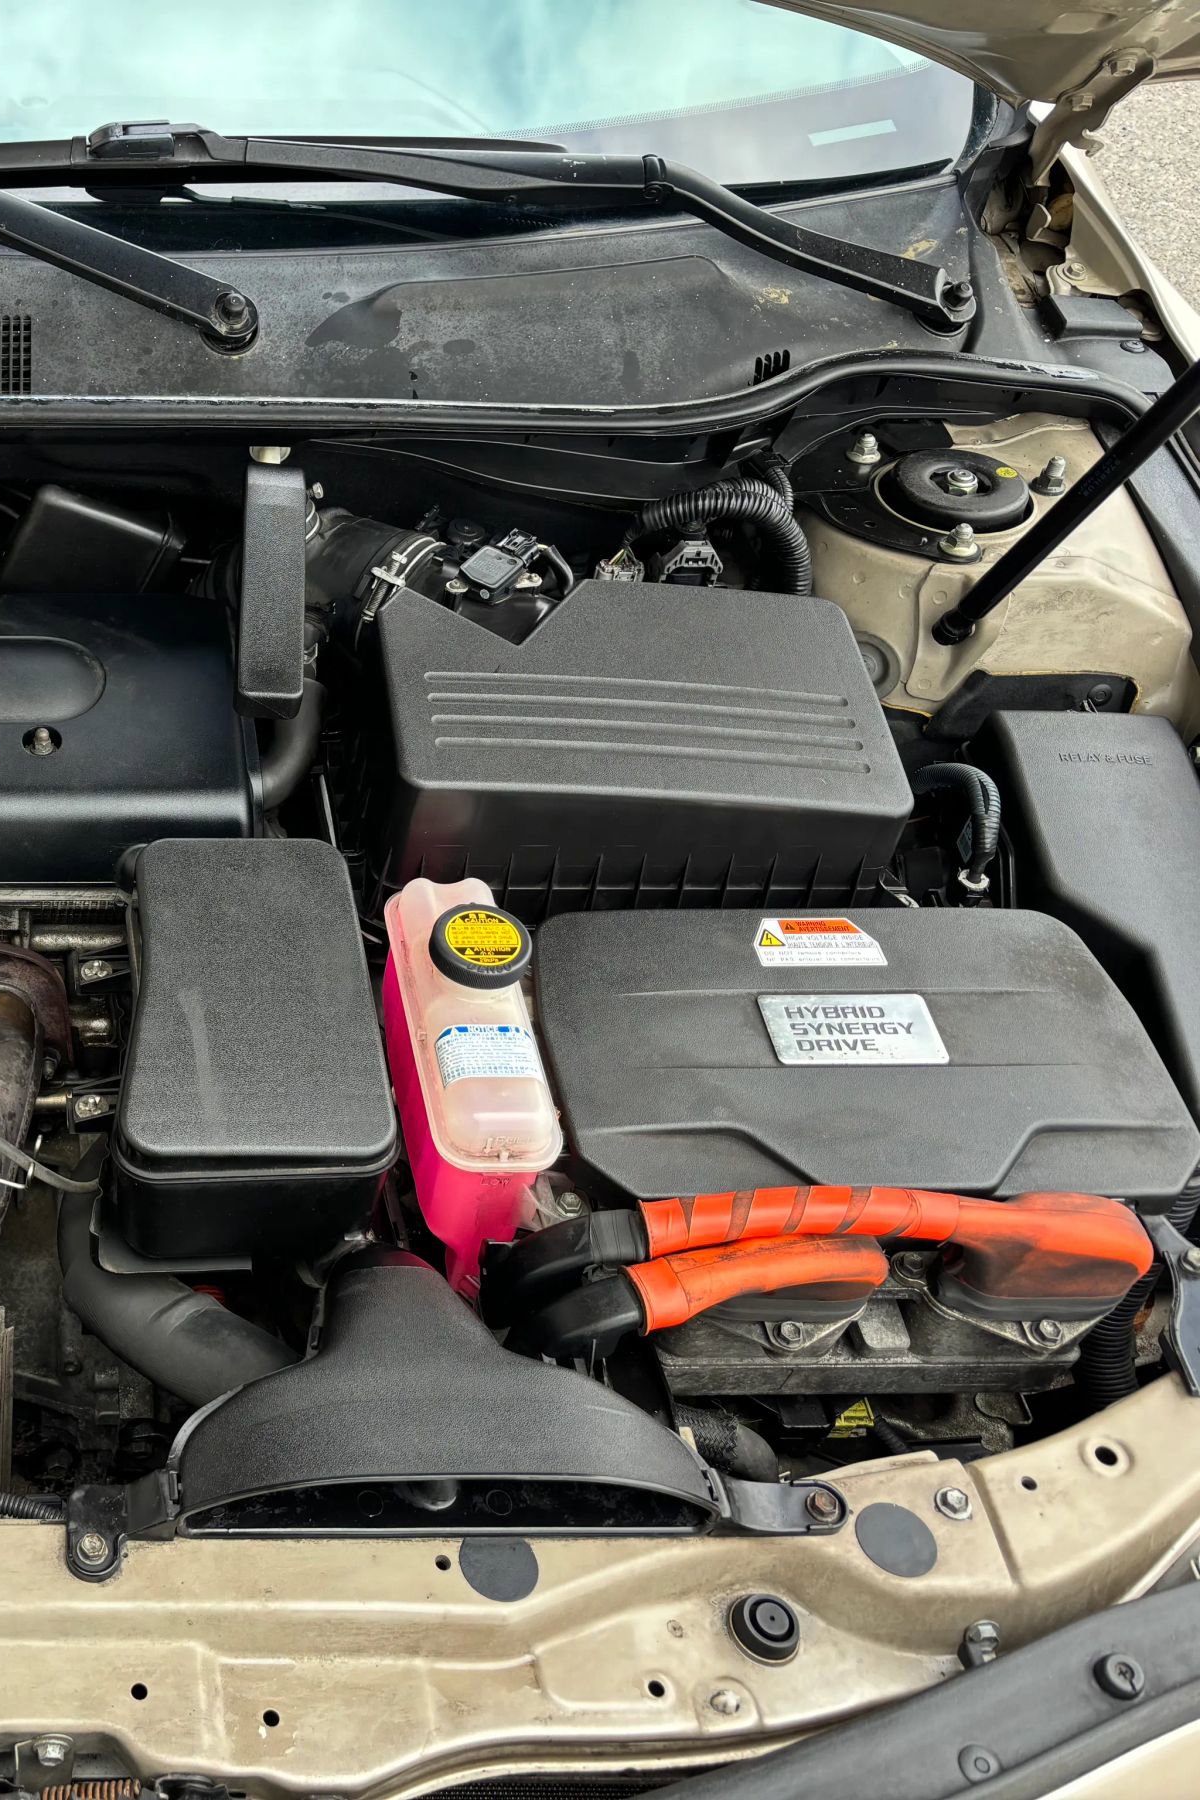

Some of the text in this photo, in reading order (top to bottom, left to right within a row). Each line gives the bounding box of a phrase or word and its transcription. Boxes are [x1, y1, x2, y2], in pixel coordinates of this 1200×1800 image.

[1116, 754, 1153, 766] FUSE
[783, 1006, 885, 1019] HYBRID
[789, 1022, 914, 1036] SYNERGY
[796, 1038, 878, 1052] DRIVE
